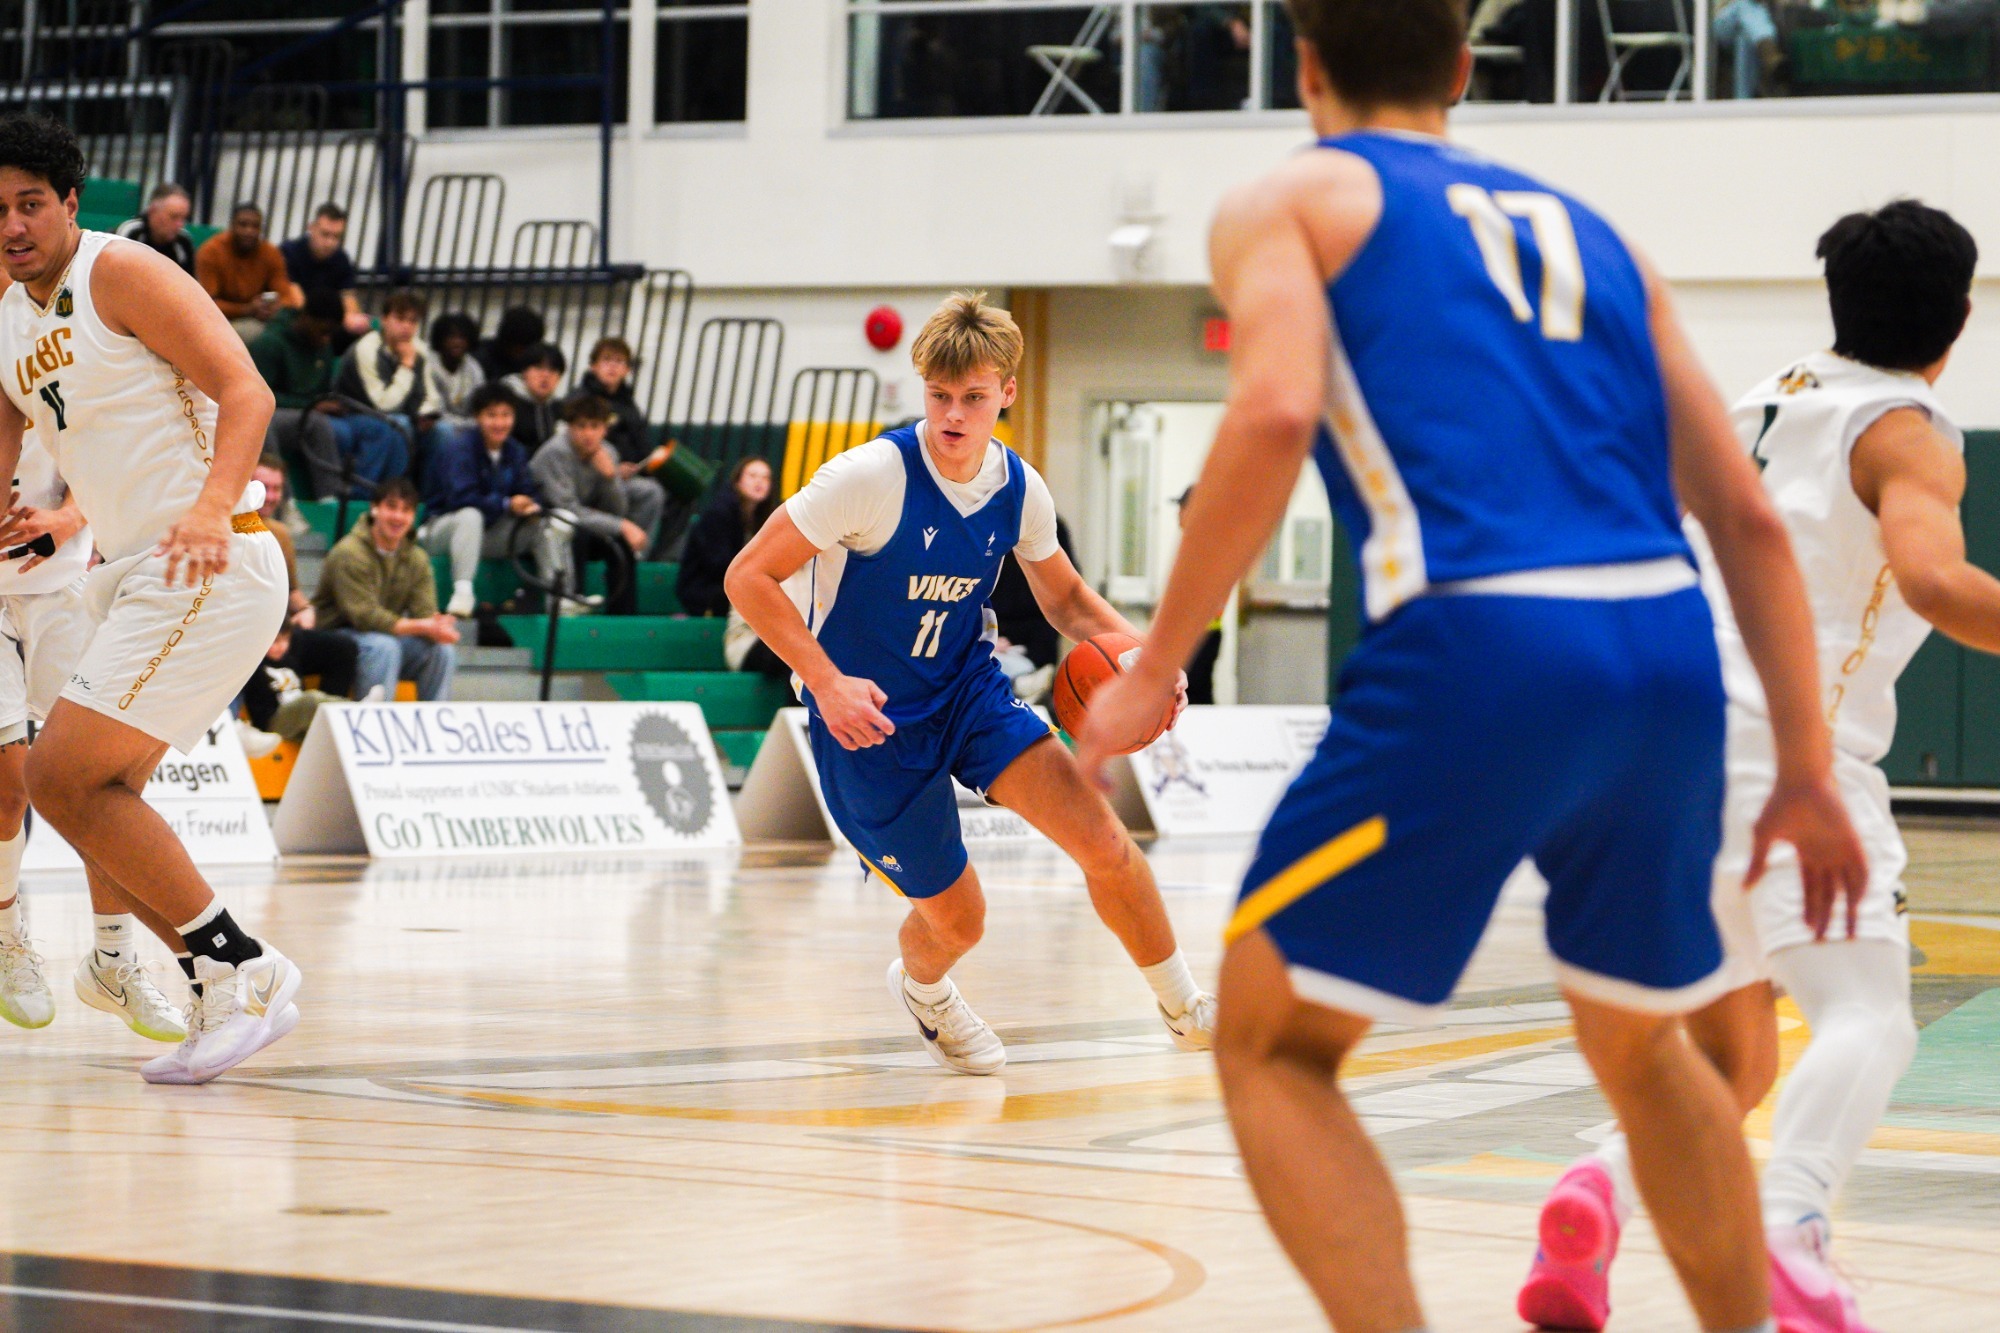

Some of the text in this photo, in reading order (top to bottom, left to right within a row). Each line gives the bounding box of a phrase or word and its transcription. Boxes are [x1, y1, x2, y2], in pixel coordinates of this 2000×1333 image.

[1446, 182, 1586, 342] 17
[907, 574, 982, 603] VIKES
[910, 609, 949, 658] 11
[340, 705, 611, 767] KJM Sales Ltd.
